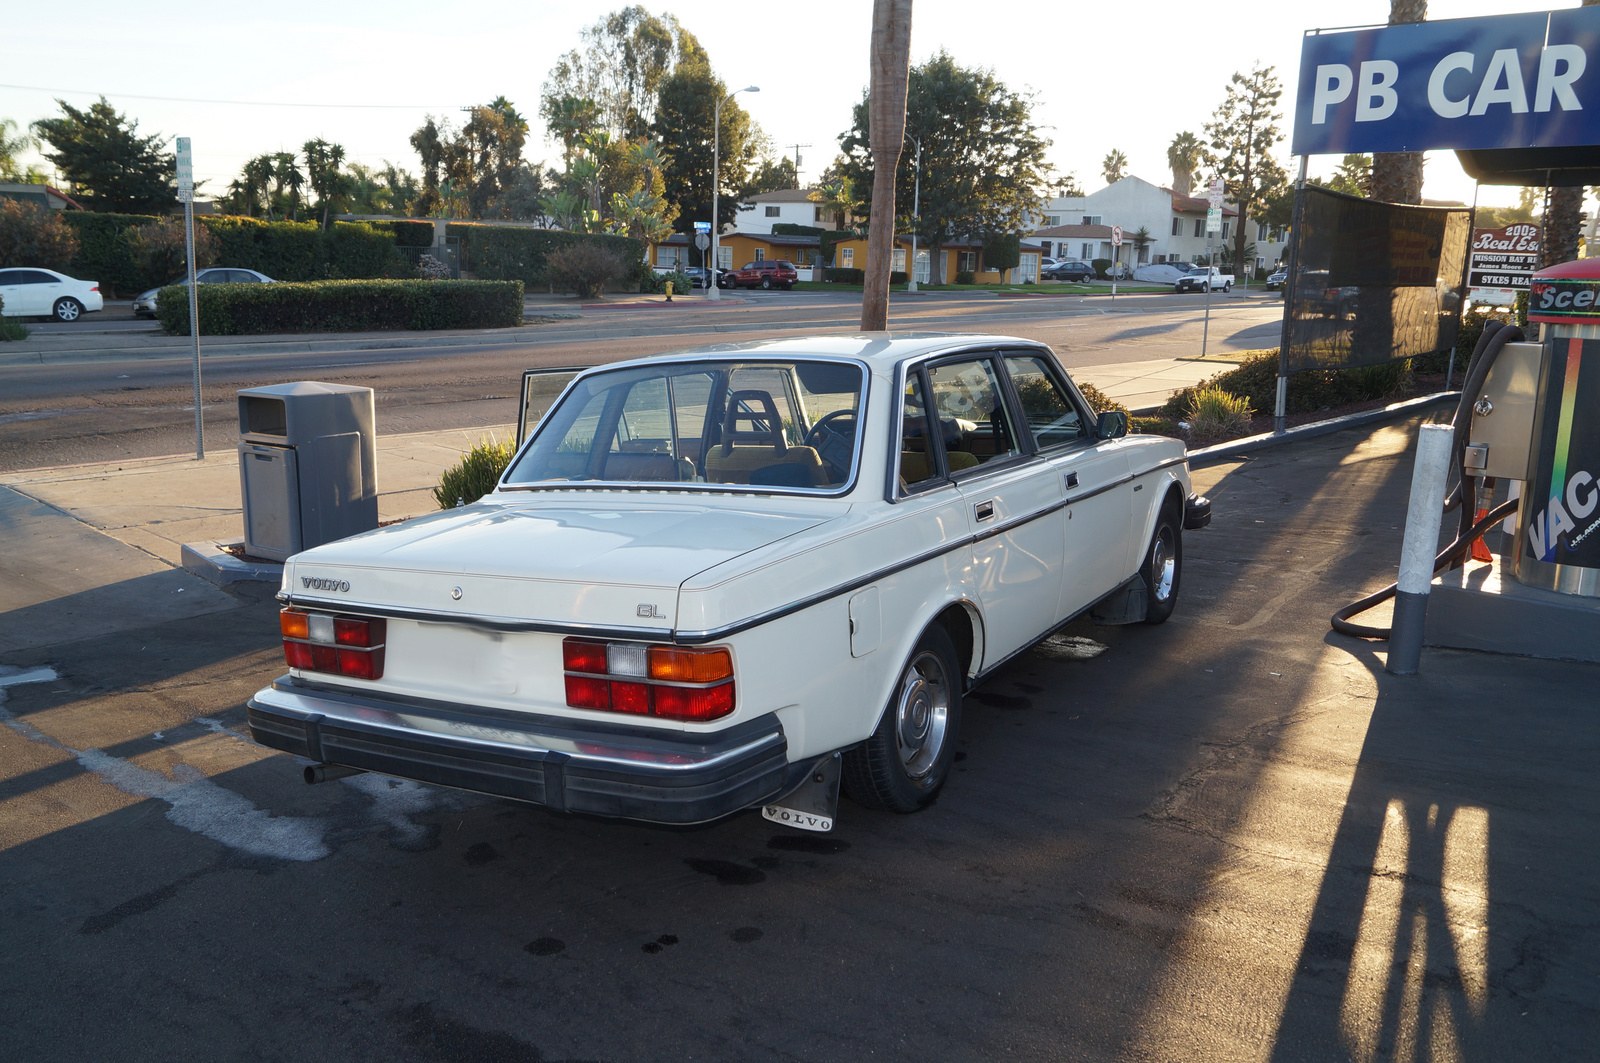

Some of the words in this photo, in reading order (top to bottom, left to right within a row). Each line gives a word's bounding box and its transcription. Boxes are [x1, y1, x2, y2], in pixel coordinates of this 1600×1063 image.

[1312, 60, 1399, 124] PB
[1427, 44, 1587, 118] CAR
[1506, 225, 1537, 236] 2002
[1473, 233, 1519, 250] Real
[1474, 255, 1507, 263] MISSION
[1508, 256, 1526, 264] BAY
[1481, 275, 1510, 285] SYKES
[1528, 470, 1600, 561] VAC
[301, 576, 351, 593] VOLVO
[636, 603, 666, 619] GL
[766, 807, 830, 830] VOLVO
